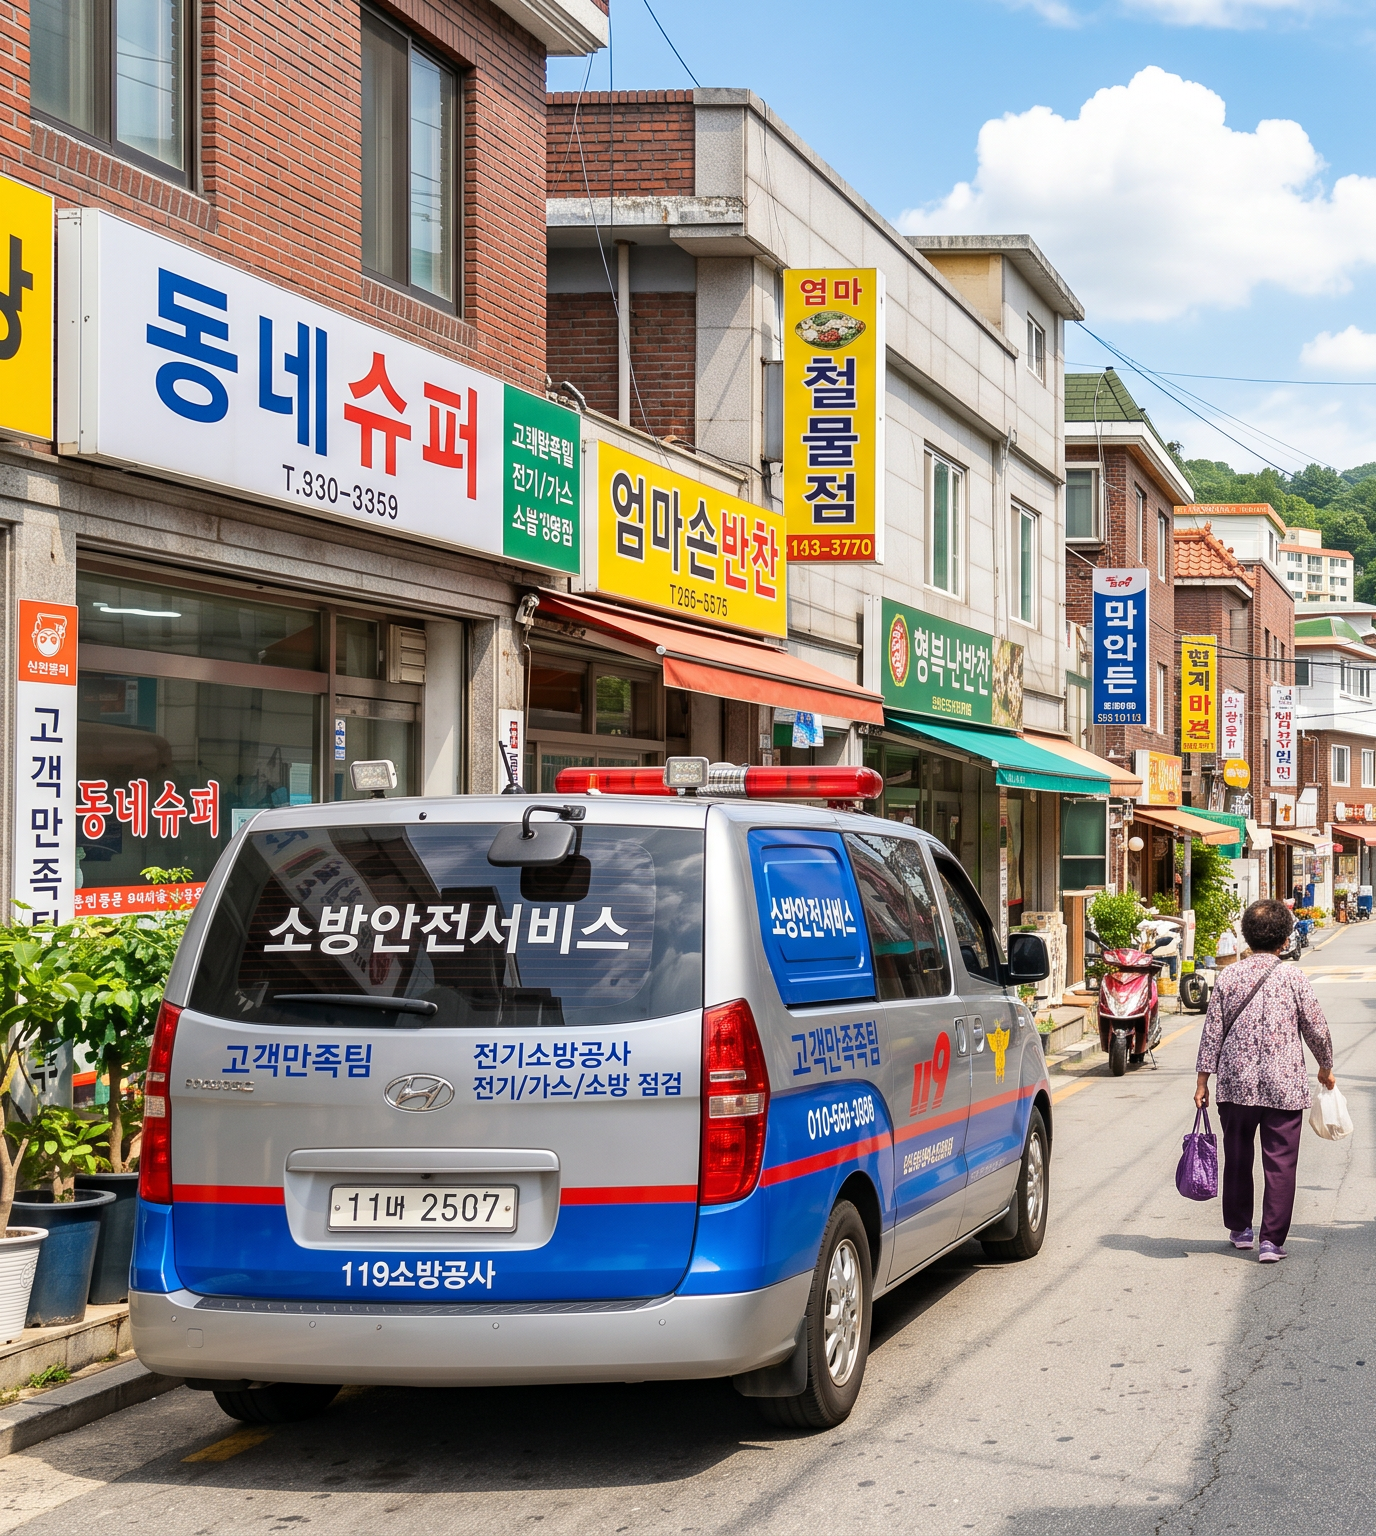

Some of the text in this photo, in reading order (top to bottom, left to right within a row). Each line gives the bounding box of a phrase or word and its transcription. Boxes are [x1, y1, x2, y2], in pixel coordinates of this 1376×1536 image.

[147, 267, 477, 500] 동네슈퍼
[802, 356, 858, 525] 철물점
[512, 463, 574, 505] 전기/가스
[611, 470, 779, 599] 엄마손반찬
[76, 778, 220, 838] 동네슈퍼
[264, 903, 630, 955] 소방안전서비스
[771, 896, 857, 939] 소방안전서비스
[222, 1042, 373, 1079] 고객만족팀
[473, 1041, 632, 1070] 전기소방공사
[909, 1031, 951, 1118] 119
[472, 1071, 683, 1101] 전기/가스/소방 점검
[341, 1259, 497, 1290] 119소방공사
